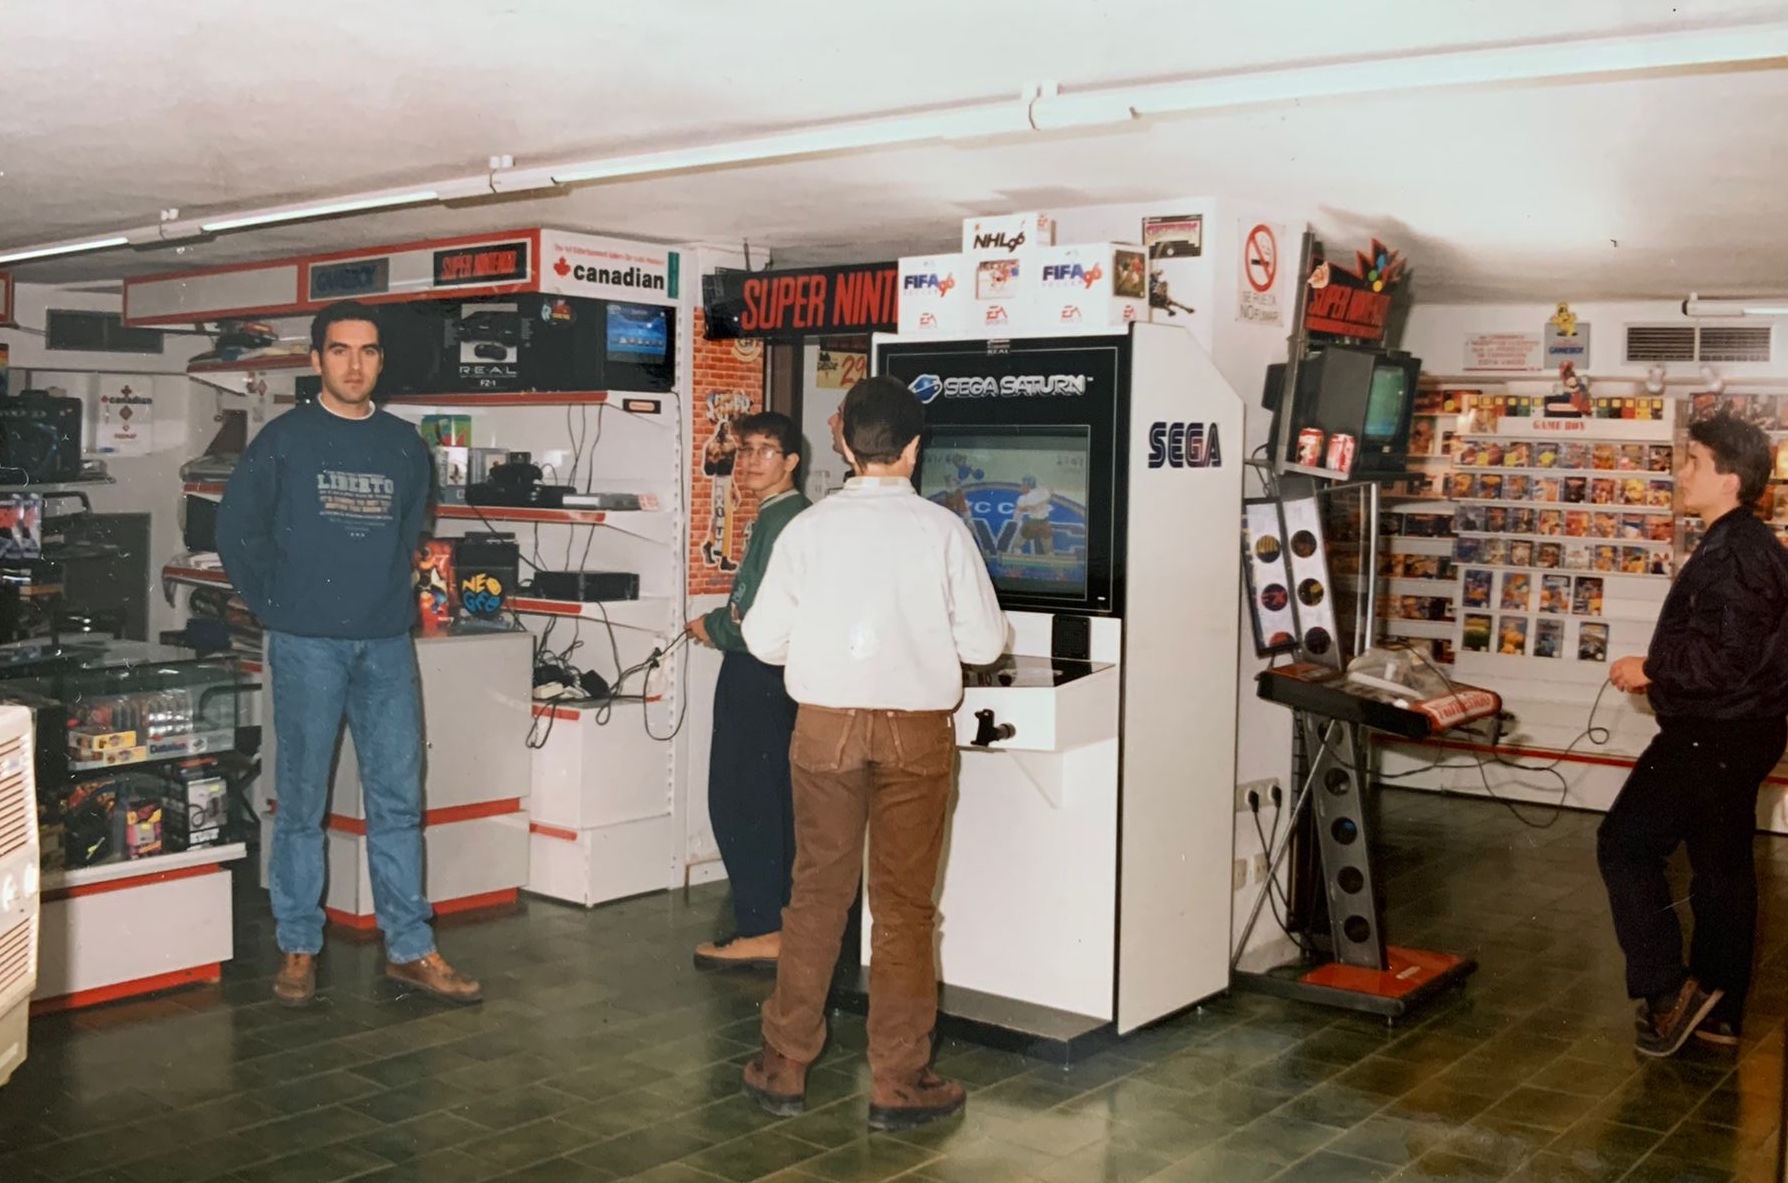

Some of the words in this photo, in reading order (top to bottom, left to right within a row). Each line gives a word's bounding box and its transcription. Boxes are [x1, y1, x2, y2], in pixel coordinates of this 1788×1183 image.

[573, 264, 665, 290] canadian
[741, 274, 828, 331] SUPER
[944, 375, 998, 398] SEGA
[999, 373, 1086, 398] SATURN
[1147, 421, 1222, 469] SEGA
[462, 573, 503, 596] NEO
[463, 590, 501, 614] GEO
